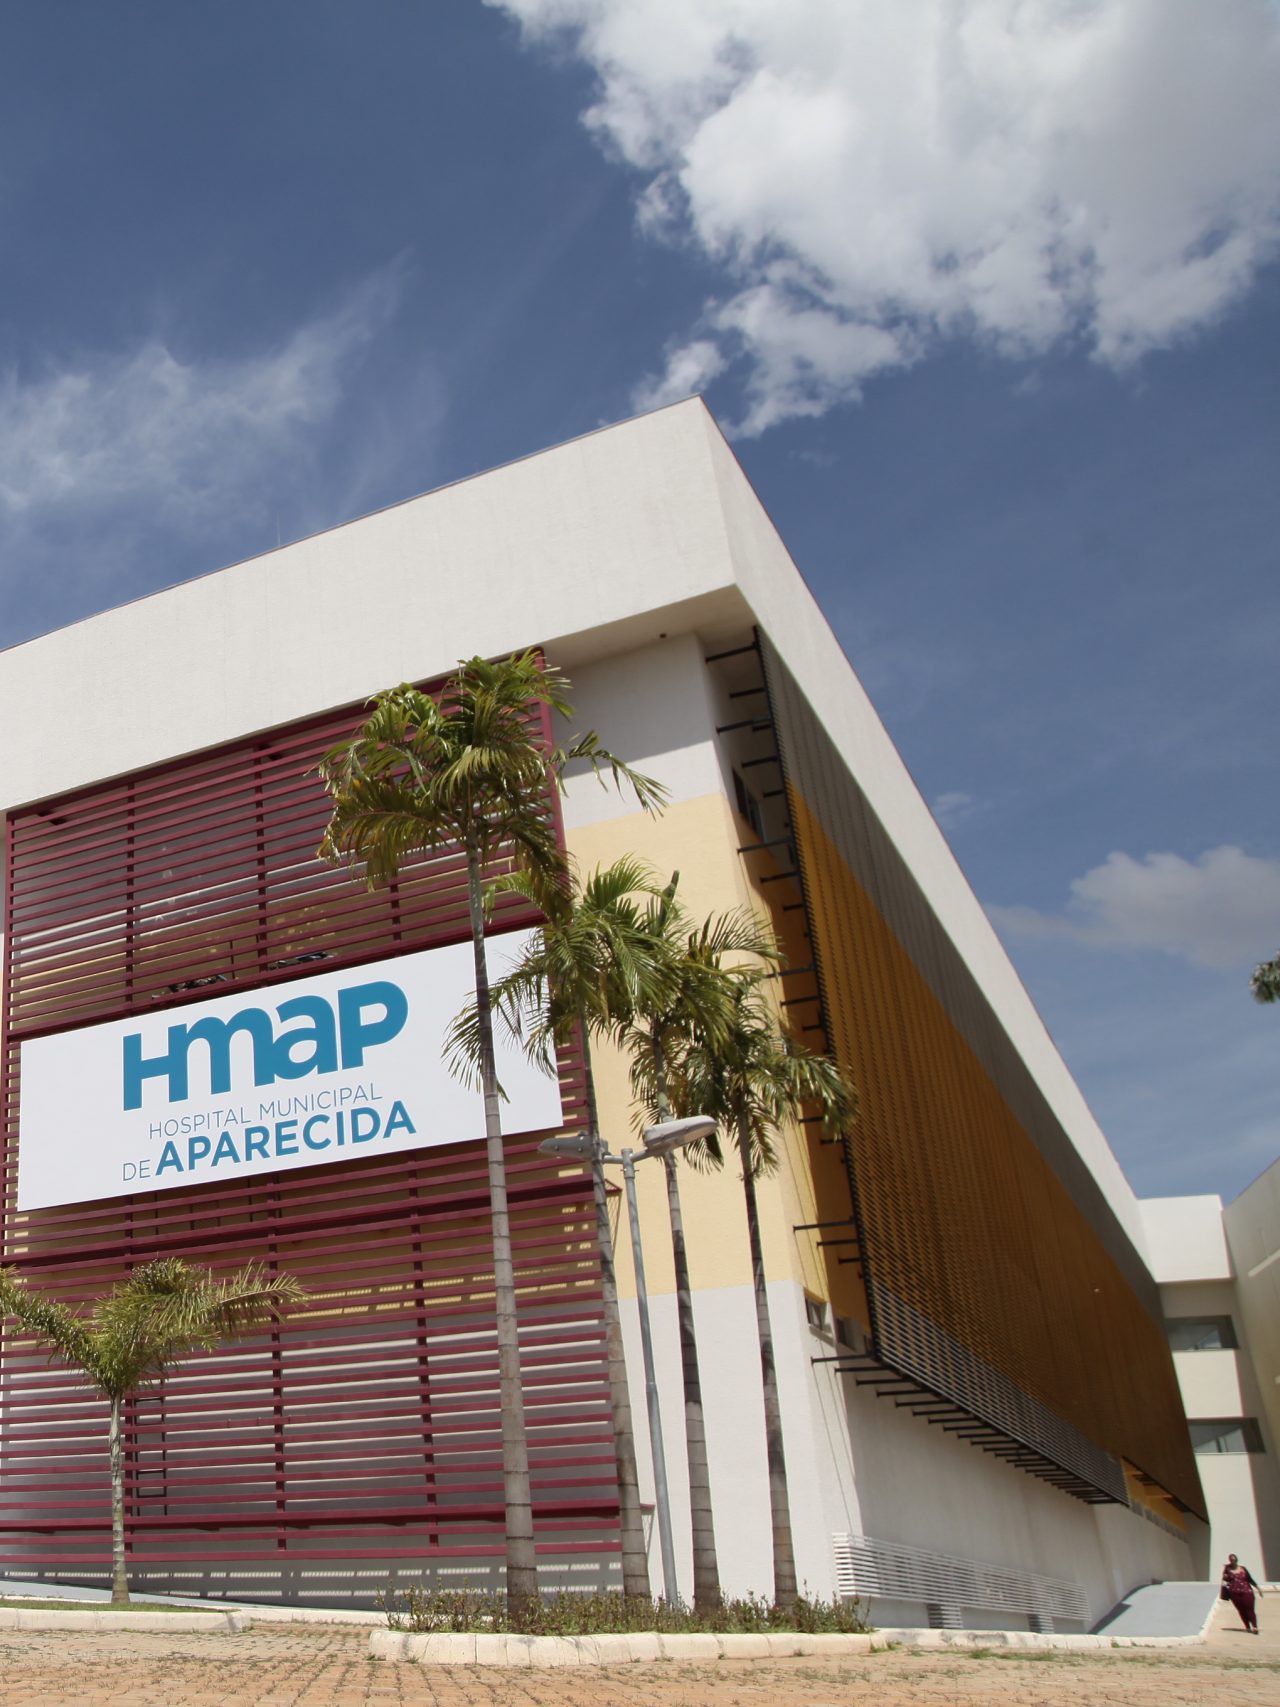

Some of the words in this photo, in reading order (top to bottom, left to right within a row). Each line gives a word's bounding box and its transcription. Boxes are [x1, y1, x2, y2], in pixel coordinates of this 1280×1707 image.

[122, 1159, 151, 1182] DE
[155, 1100, 417, 1176] APARECIDA
[148, 1106, 252, 1140] HOSPITAL
[259, 1082, 383, 1117] MUNICIPAL
